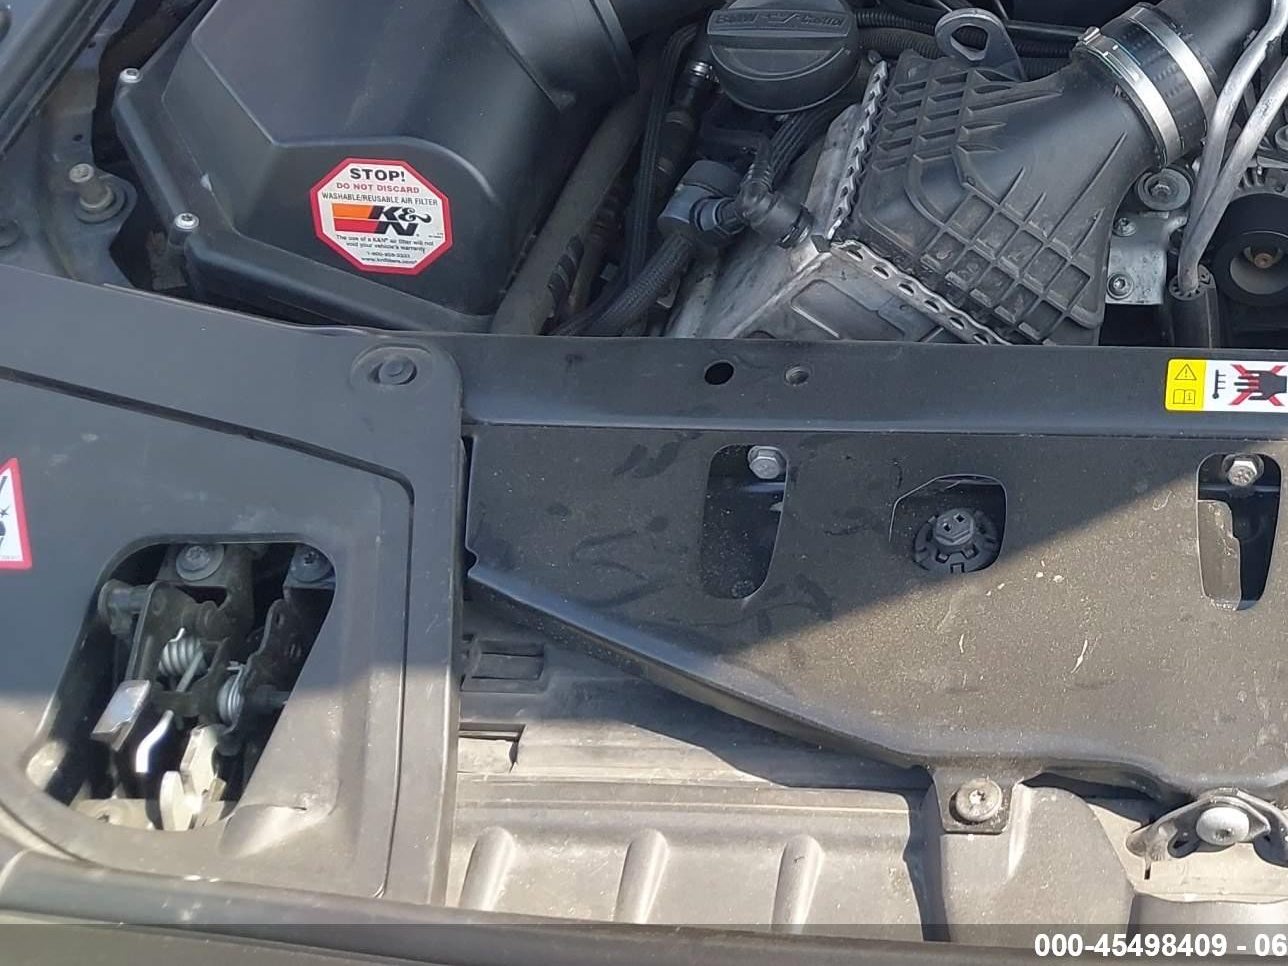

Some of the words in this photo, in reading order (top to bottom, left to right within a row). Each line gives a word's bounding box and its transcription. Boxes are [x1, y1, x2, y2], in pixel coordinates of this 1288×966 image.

[350, 168, 406, 182] STOP!
[377, 184, 419, 194] DISCARD
[322, 192, 399, 203] WASHABLE/REUSABLE
[401, 197, 413, 205] AIR
[415, 198, 438, 206] FILTER
